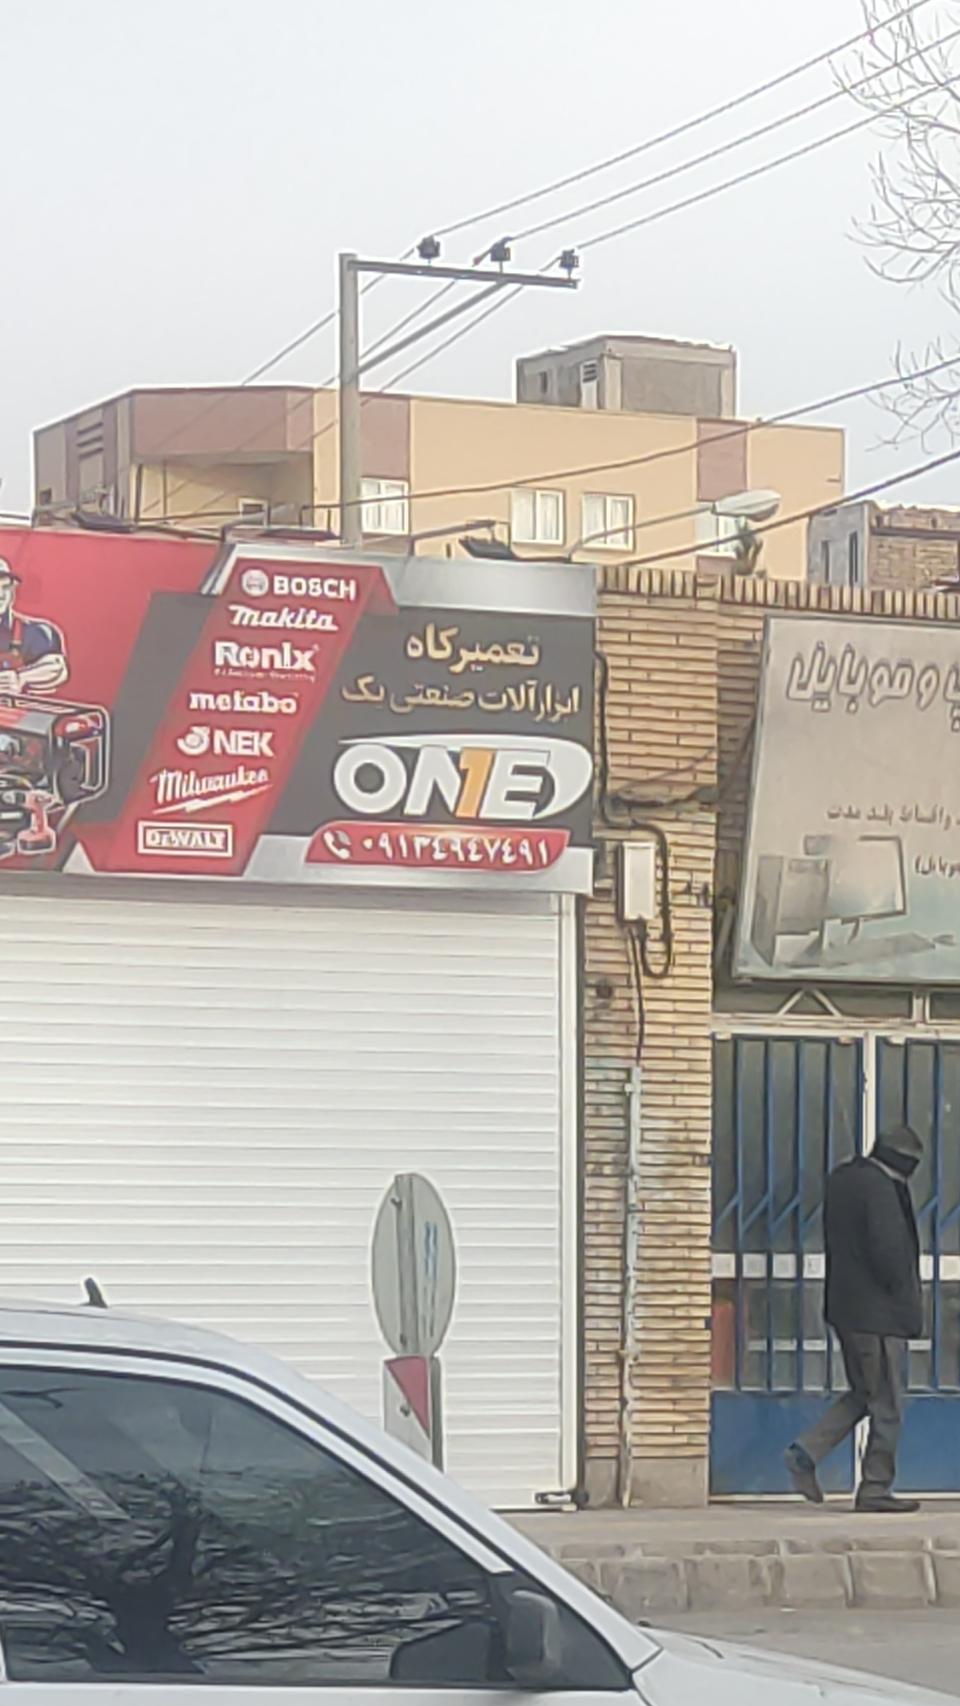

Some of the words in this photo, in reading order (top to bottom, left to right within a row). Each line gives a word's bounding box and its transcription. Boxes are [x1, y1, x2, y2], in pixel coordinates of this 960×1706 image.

[273, 575, 357, 601] BOSCH
[228, 604, 339, 631] makita
[214, 641, 317, 671] Ronix
[406, 623, 540, 673] تعمیرکاه
[189, 690, 297, 714] metabo
[390, 683, 475, 713] صنعتی
[213, 729, 275, 757] NEK
[149, 765, 270, 806] Milwaukee
